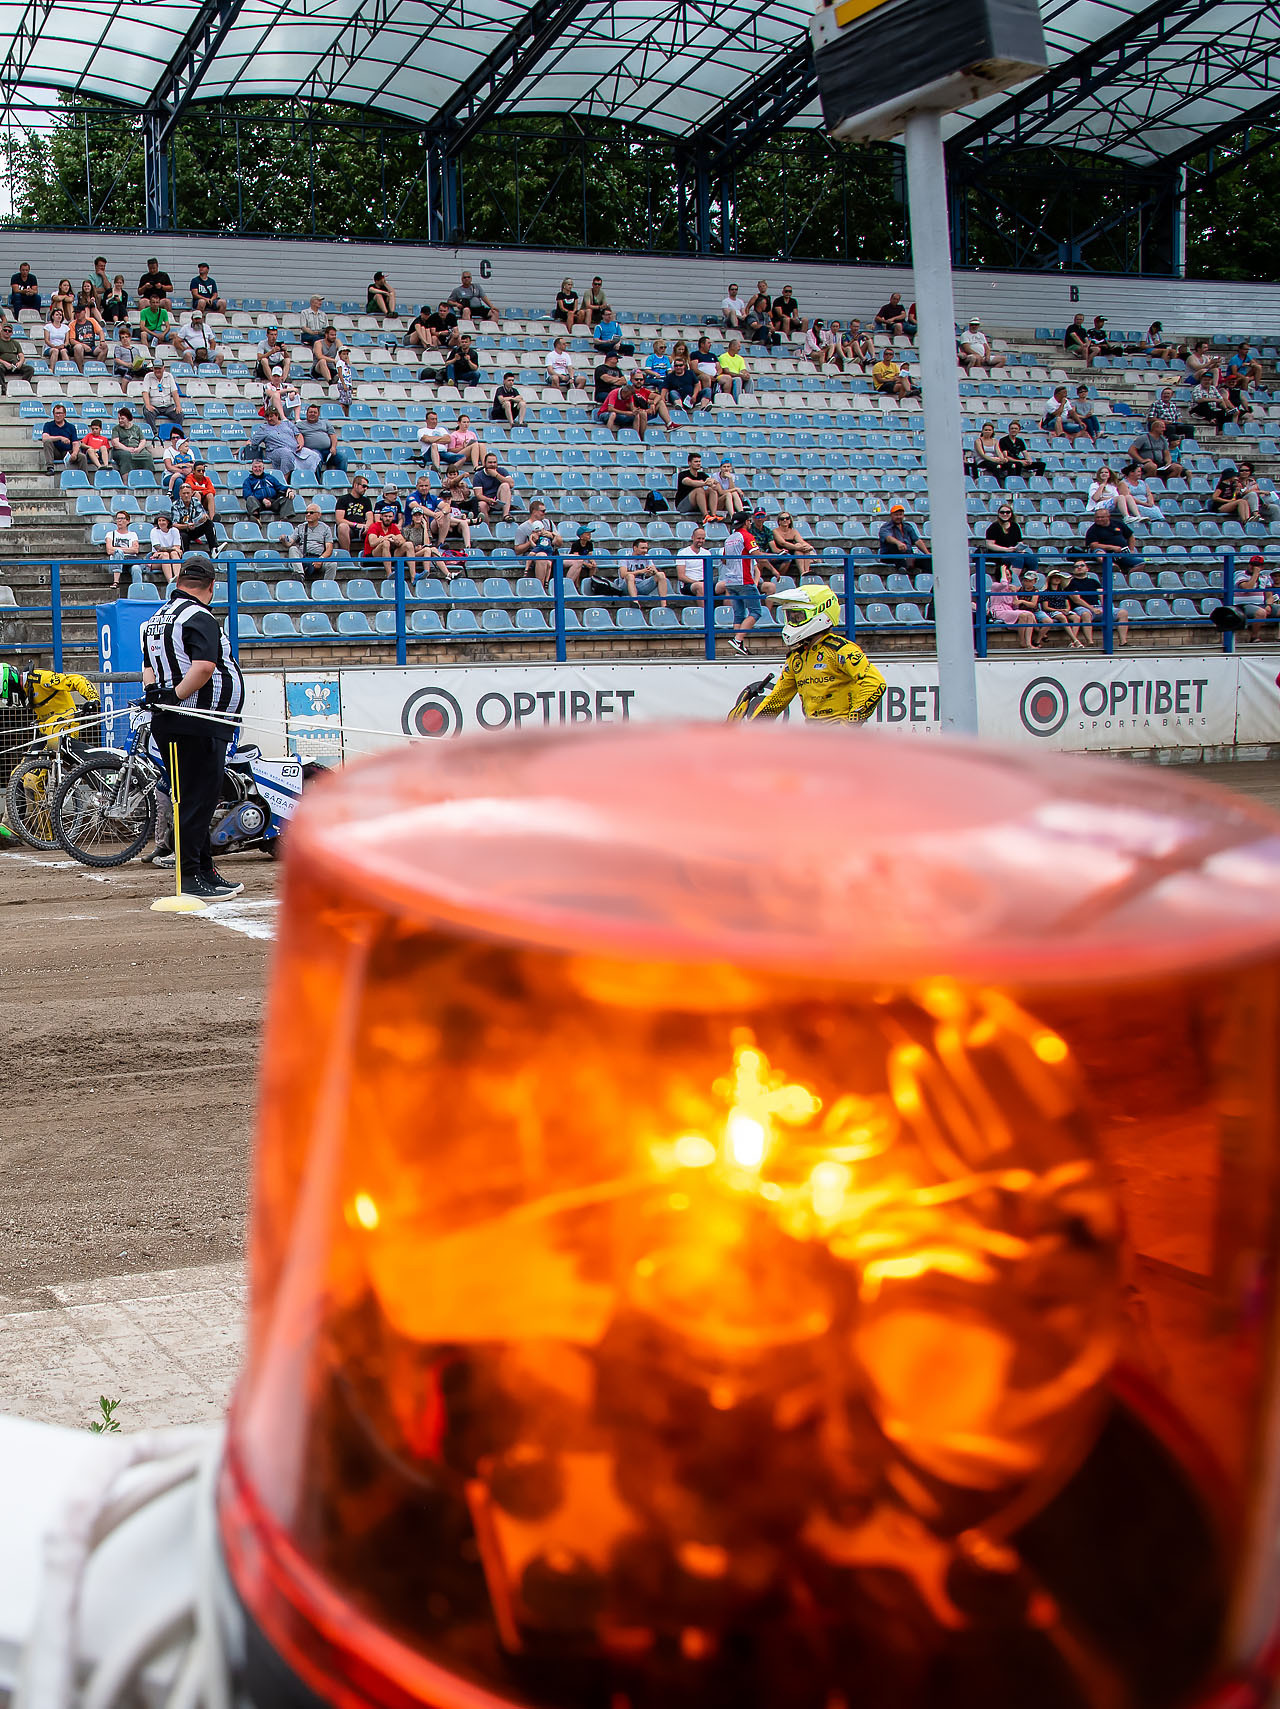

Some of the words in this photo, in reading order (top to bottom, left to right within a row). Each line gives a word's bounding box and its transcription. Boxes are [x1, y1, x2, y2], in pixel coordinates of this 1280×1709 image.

[479, 259, 492, 279] C
[1070, 285, 1080, 302] B
[876, 686, 940, 722] IBET
[1079, 679, 1209, 717] OPTIBET
[476, 690, 635, 732] OPTIBET
[1079, 719, 1150, 730] SPORTA
[1162, 716, 1207, 727] BĀRS
[282, 766, 300, 777] 30
